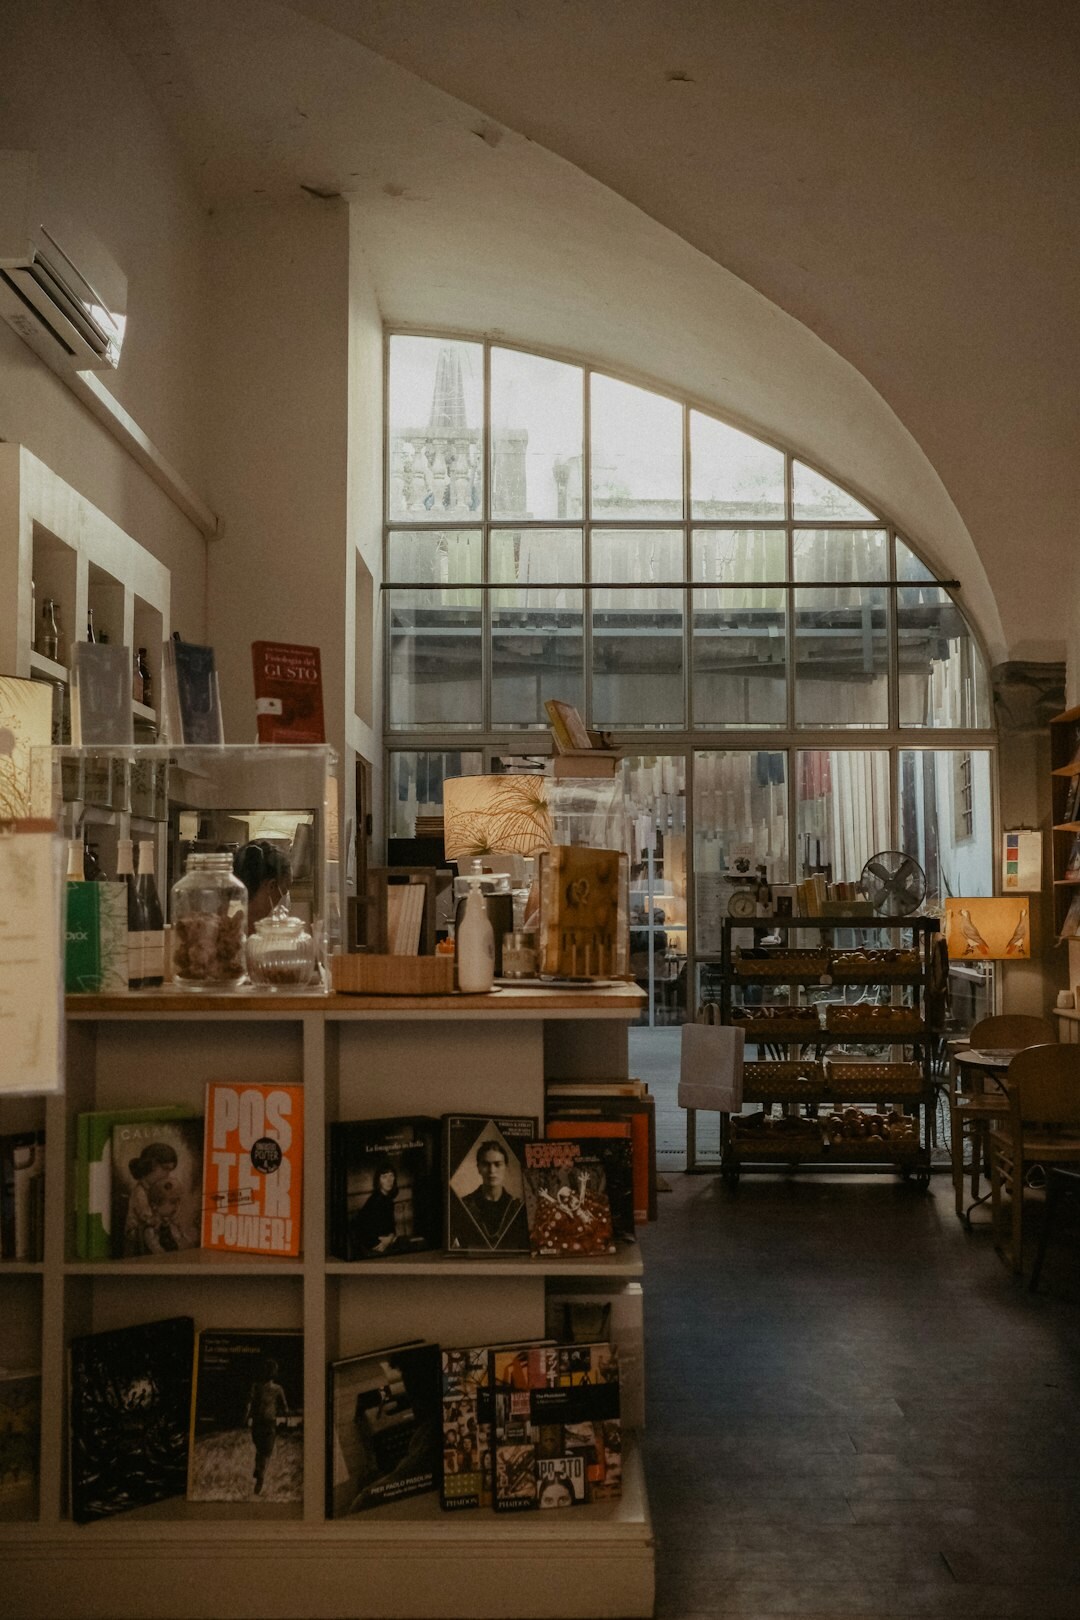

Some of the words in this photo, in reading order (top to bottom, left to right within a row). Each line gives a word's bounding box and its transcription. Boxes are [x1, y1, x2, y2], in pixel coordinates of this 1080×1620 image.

[264, 664, 318, 680] GUSTO
[213, 1088, 292, 1151] POS
[212, 1152, 291, 1217] TER
[211, 1213, 292, 1250] POWER!
[385, 1480, 405, 1490] PAOLO
